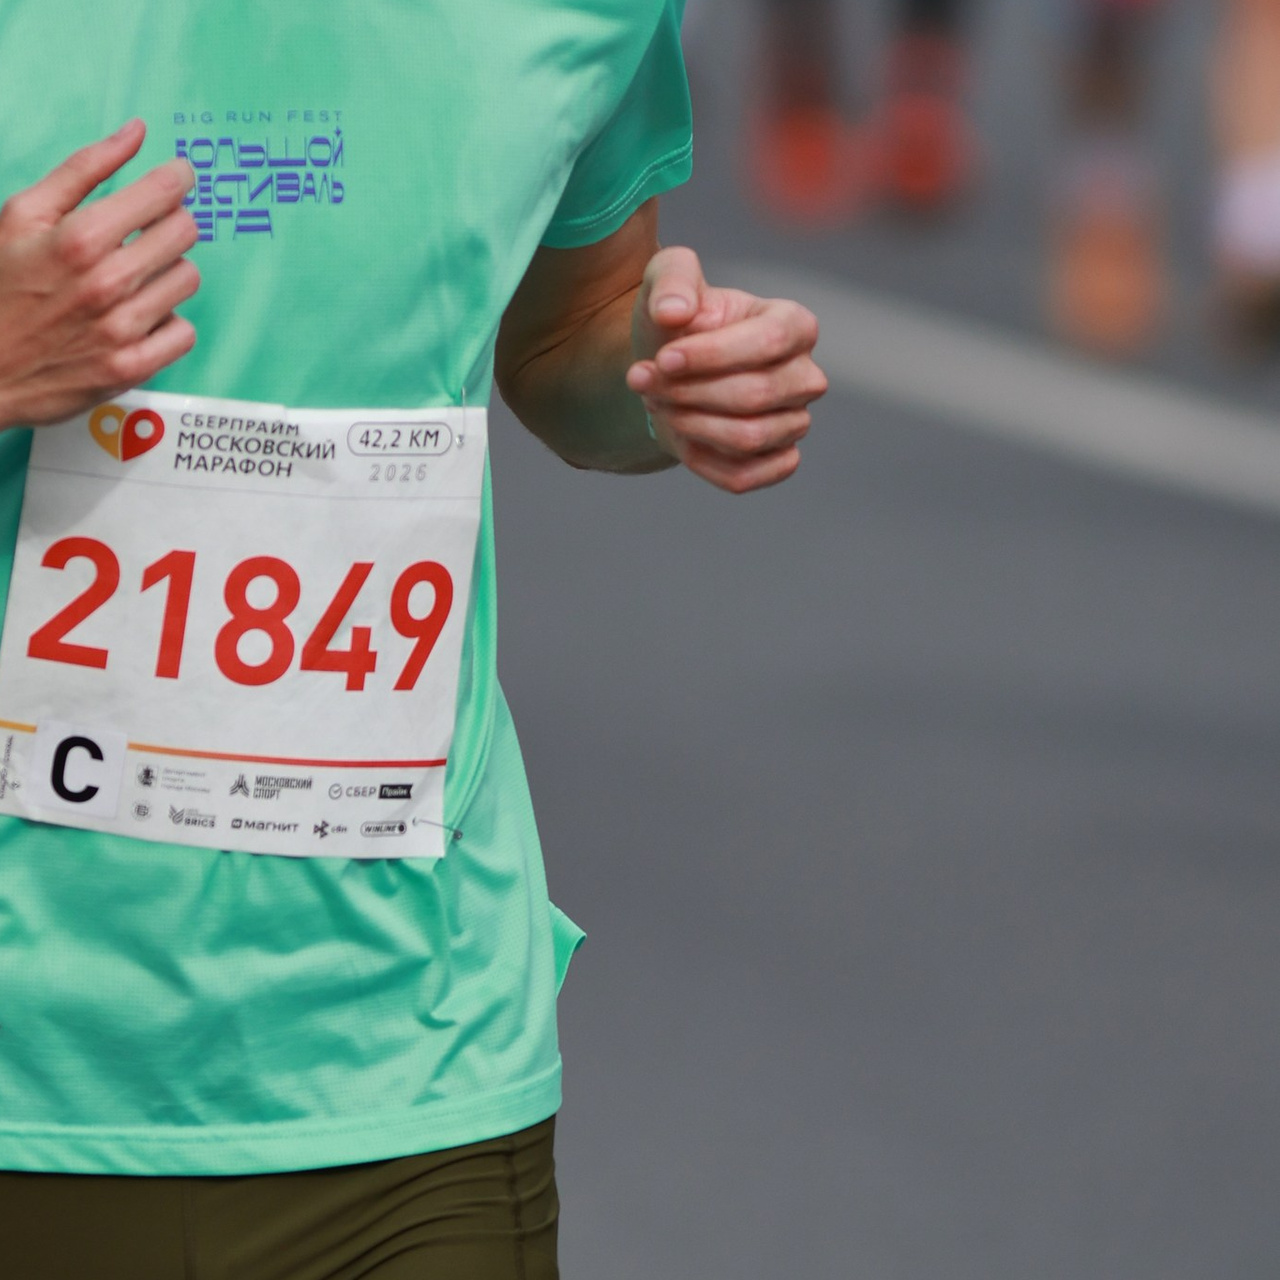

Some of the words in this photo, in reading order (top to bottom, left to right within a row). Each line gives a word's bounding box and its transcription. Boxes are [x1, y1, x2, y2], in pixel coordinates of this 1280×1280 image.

[173, 111, 213, 124] BIG
[226, 110, 270, 122] RUN
[287, 109, 342, 122] FEST
[192, 208, 274, 242] ЕГА
[180, 412, 300, 436] СБЕРПРАЙМ
[177, 431, 337, 460] МОСКОВСКИЙ
[359, 428, 402, 451] 42,2
[173, 453, 293, 478] МАРАФОН
[370, 463, 427, 482] 2026
[26, 536, 454, 692] 21849
[254, 775, 312, 790] МОСКОВСКИЙ
[253, 788, 281, 800] СПОРТ
[345, 785, 377, 798] СБЕР
[184, 816, 216, 829] BRICS
[244, 820, 299, 834] магнит
[364, 823, 397, 834] WINLINE
